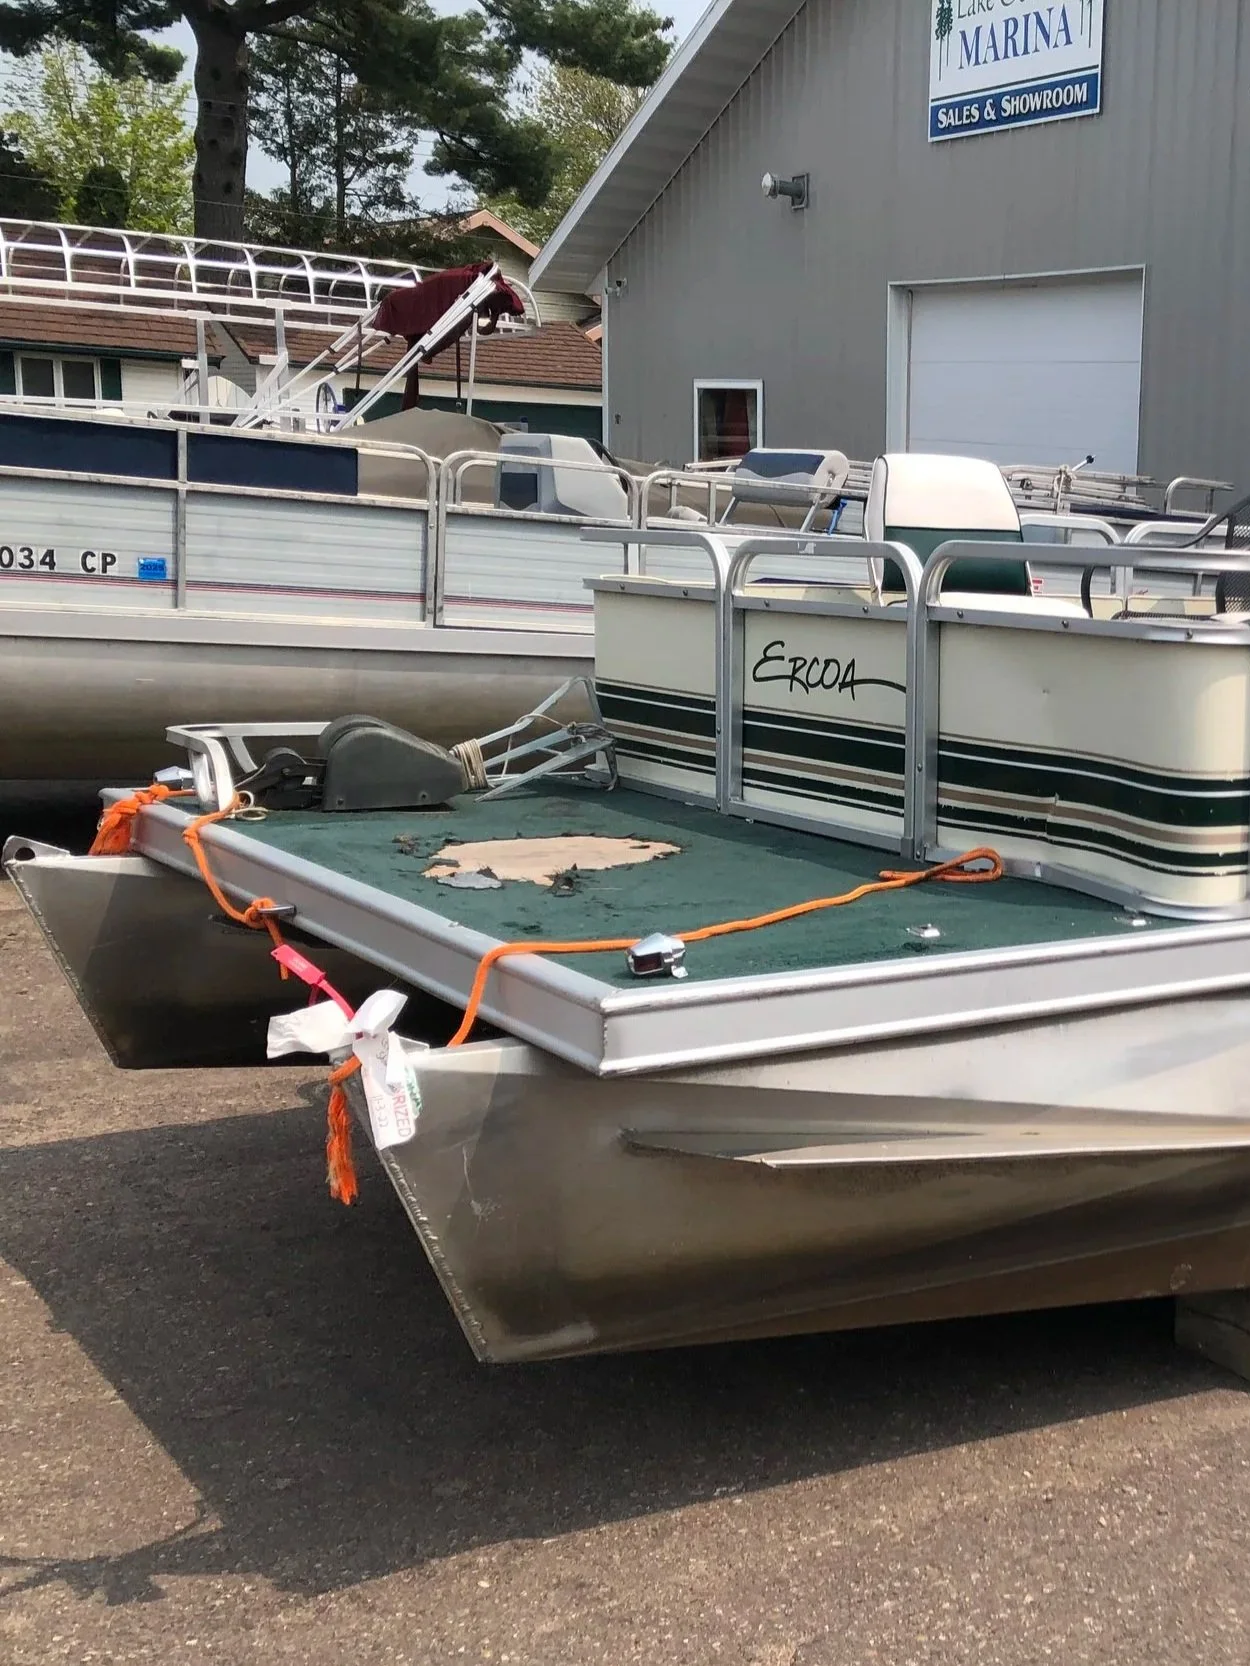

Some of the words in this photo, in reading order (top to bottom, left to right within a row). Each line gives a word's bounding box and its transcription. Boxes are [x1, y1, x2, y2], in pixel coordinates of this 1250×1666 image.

[958, 4, 1073, 70] MARINA
[984, 99, 996, 121] &
[1001, 82, 1088, 117] SHOWROOM
[0, 546, 56, 571] 034
[81, 550, 117, 574] CP
[752, 640, 907, 701] ERCOA
